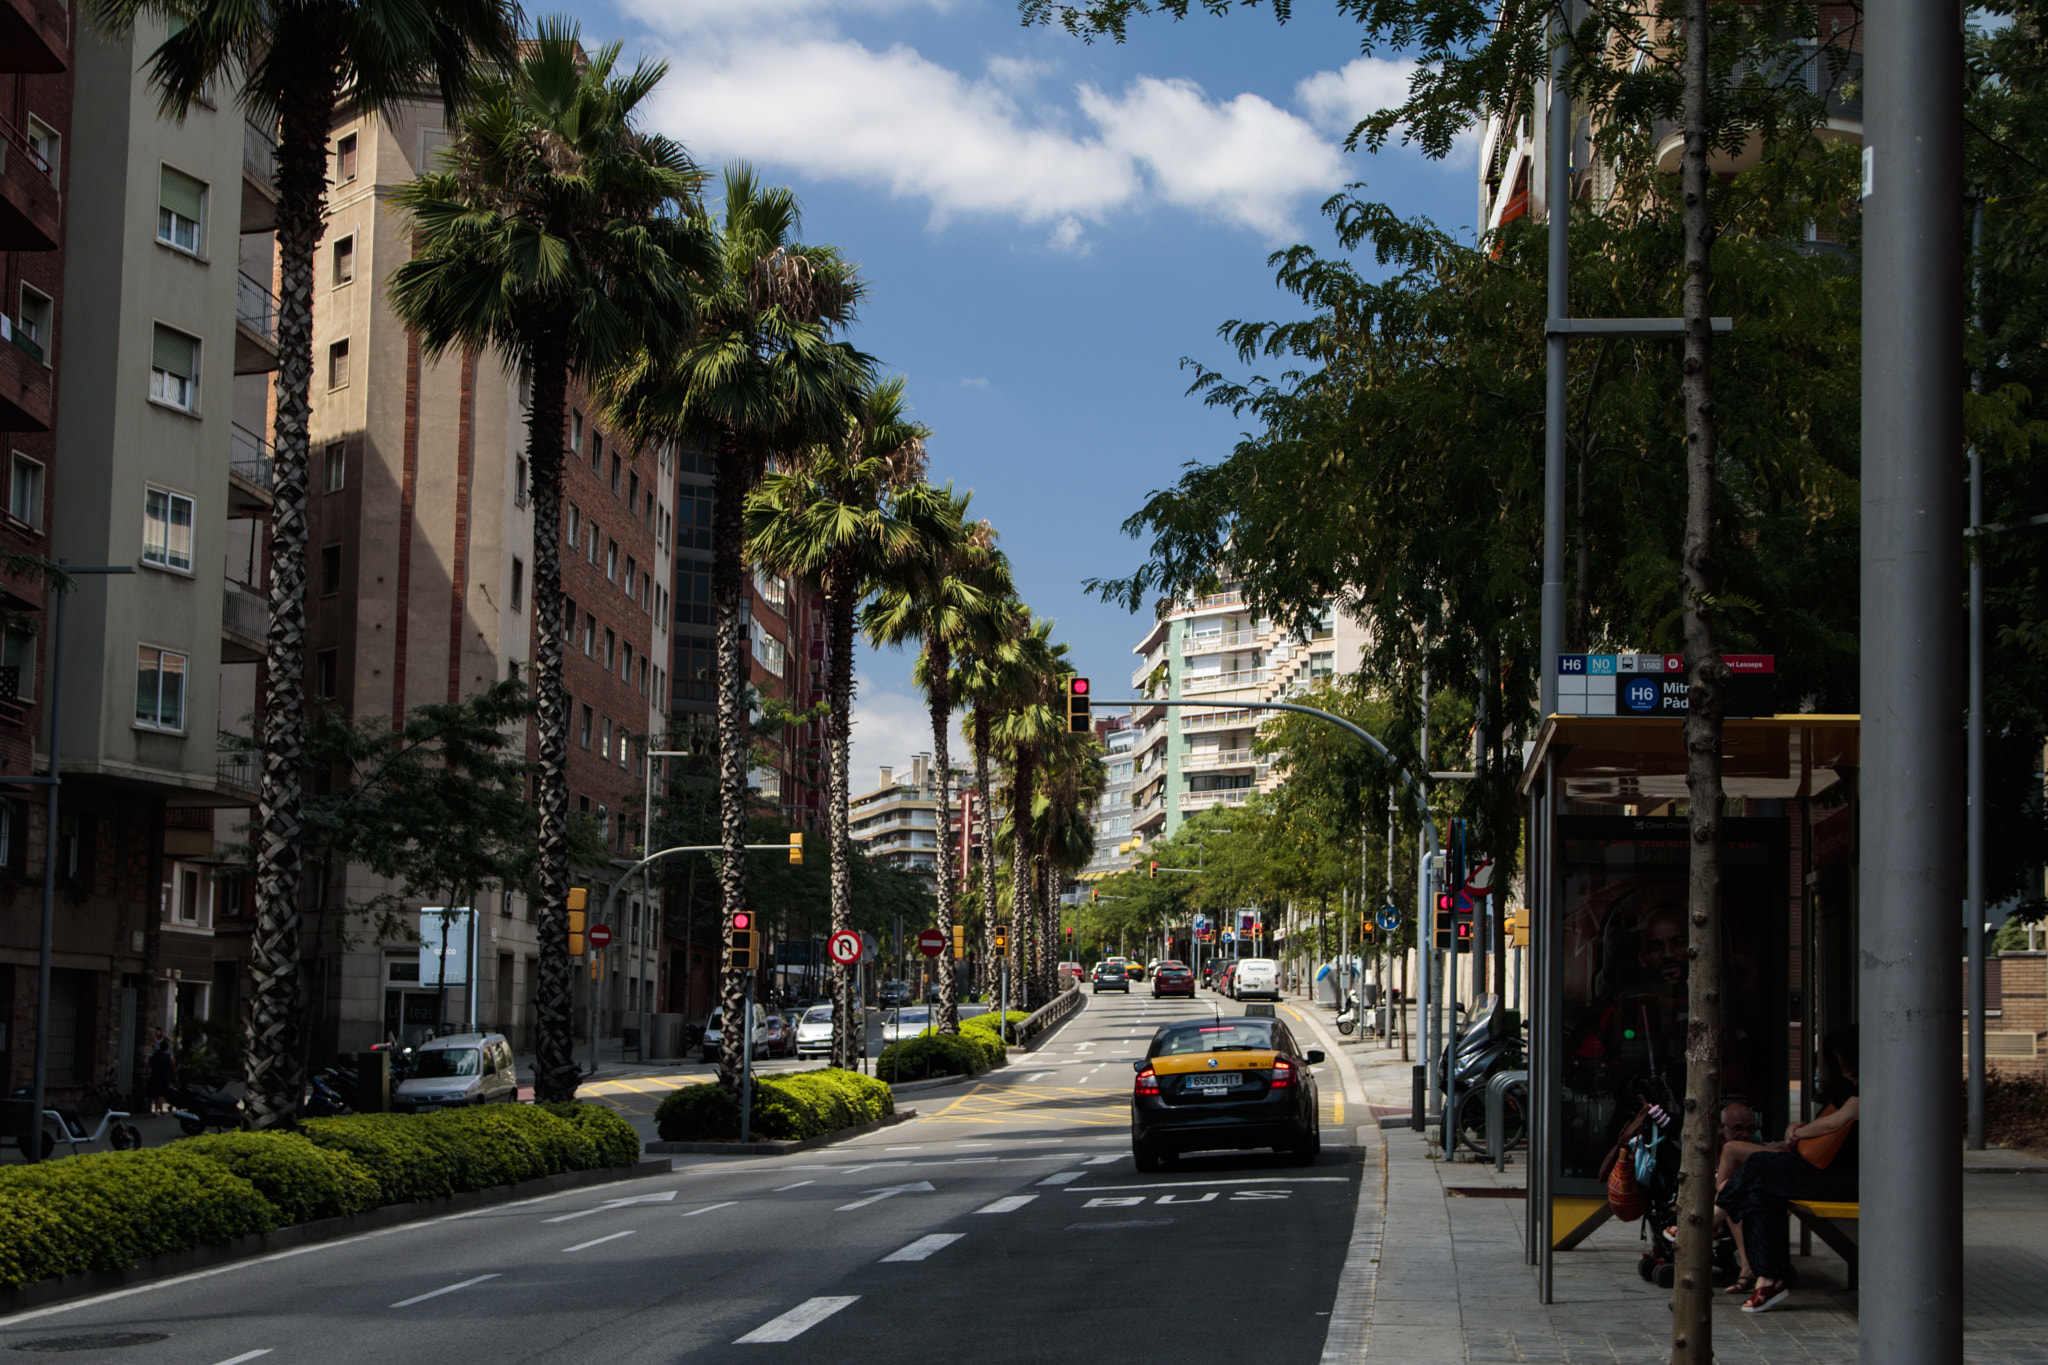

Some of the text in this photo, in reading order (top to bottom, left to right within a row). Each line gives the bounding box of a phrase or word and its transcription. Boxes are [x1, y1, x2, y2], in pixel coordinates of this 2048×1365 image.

[1563, 659, 1581, 671] H6
[1642, 662, 1661, 670] 1582
[1736, 661, 1763, 669] Lesseps
[1631, 687, 1654, 701] H6
[1663, 682, 1690, 694] Mitr
[1663, 697, 1689, 709] Pàd
[1666, 821, 1690, 829] Chann
[1194, 1074, 1240, 1086] 6500 HTY
[1081, 1190, 1293, 1208] BUS
